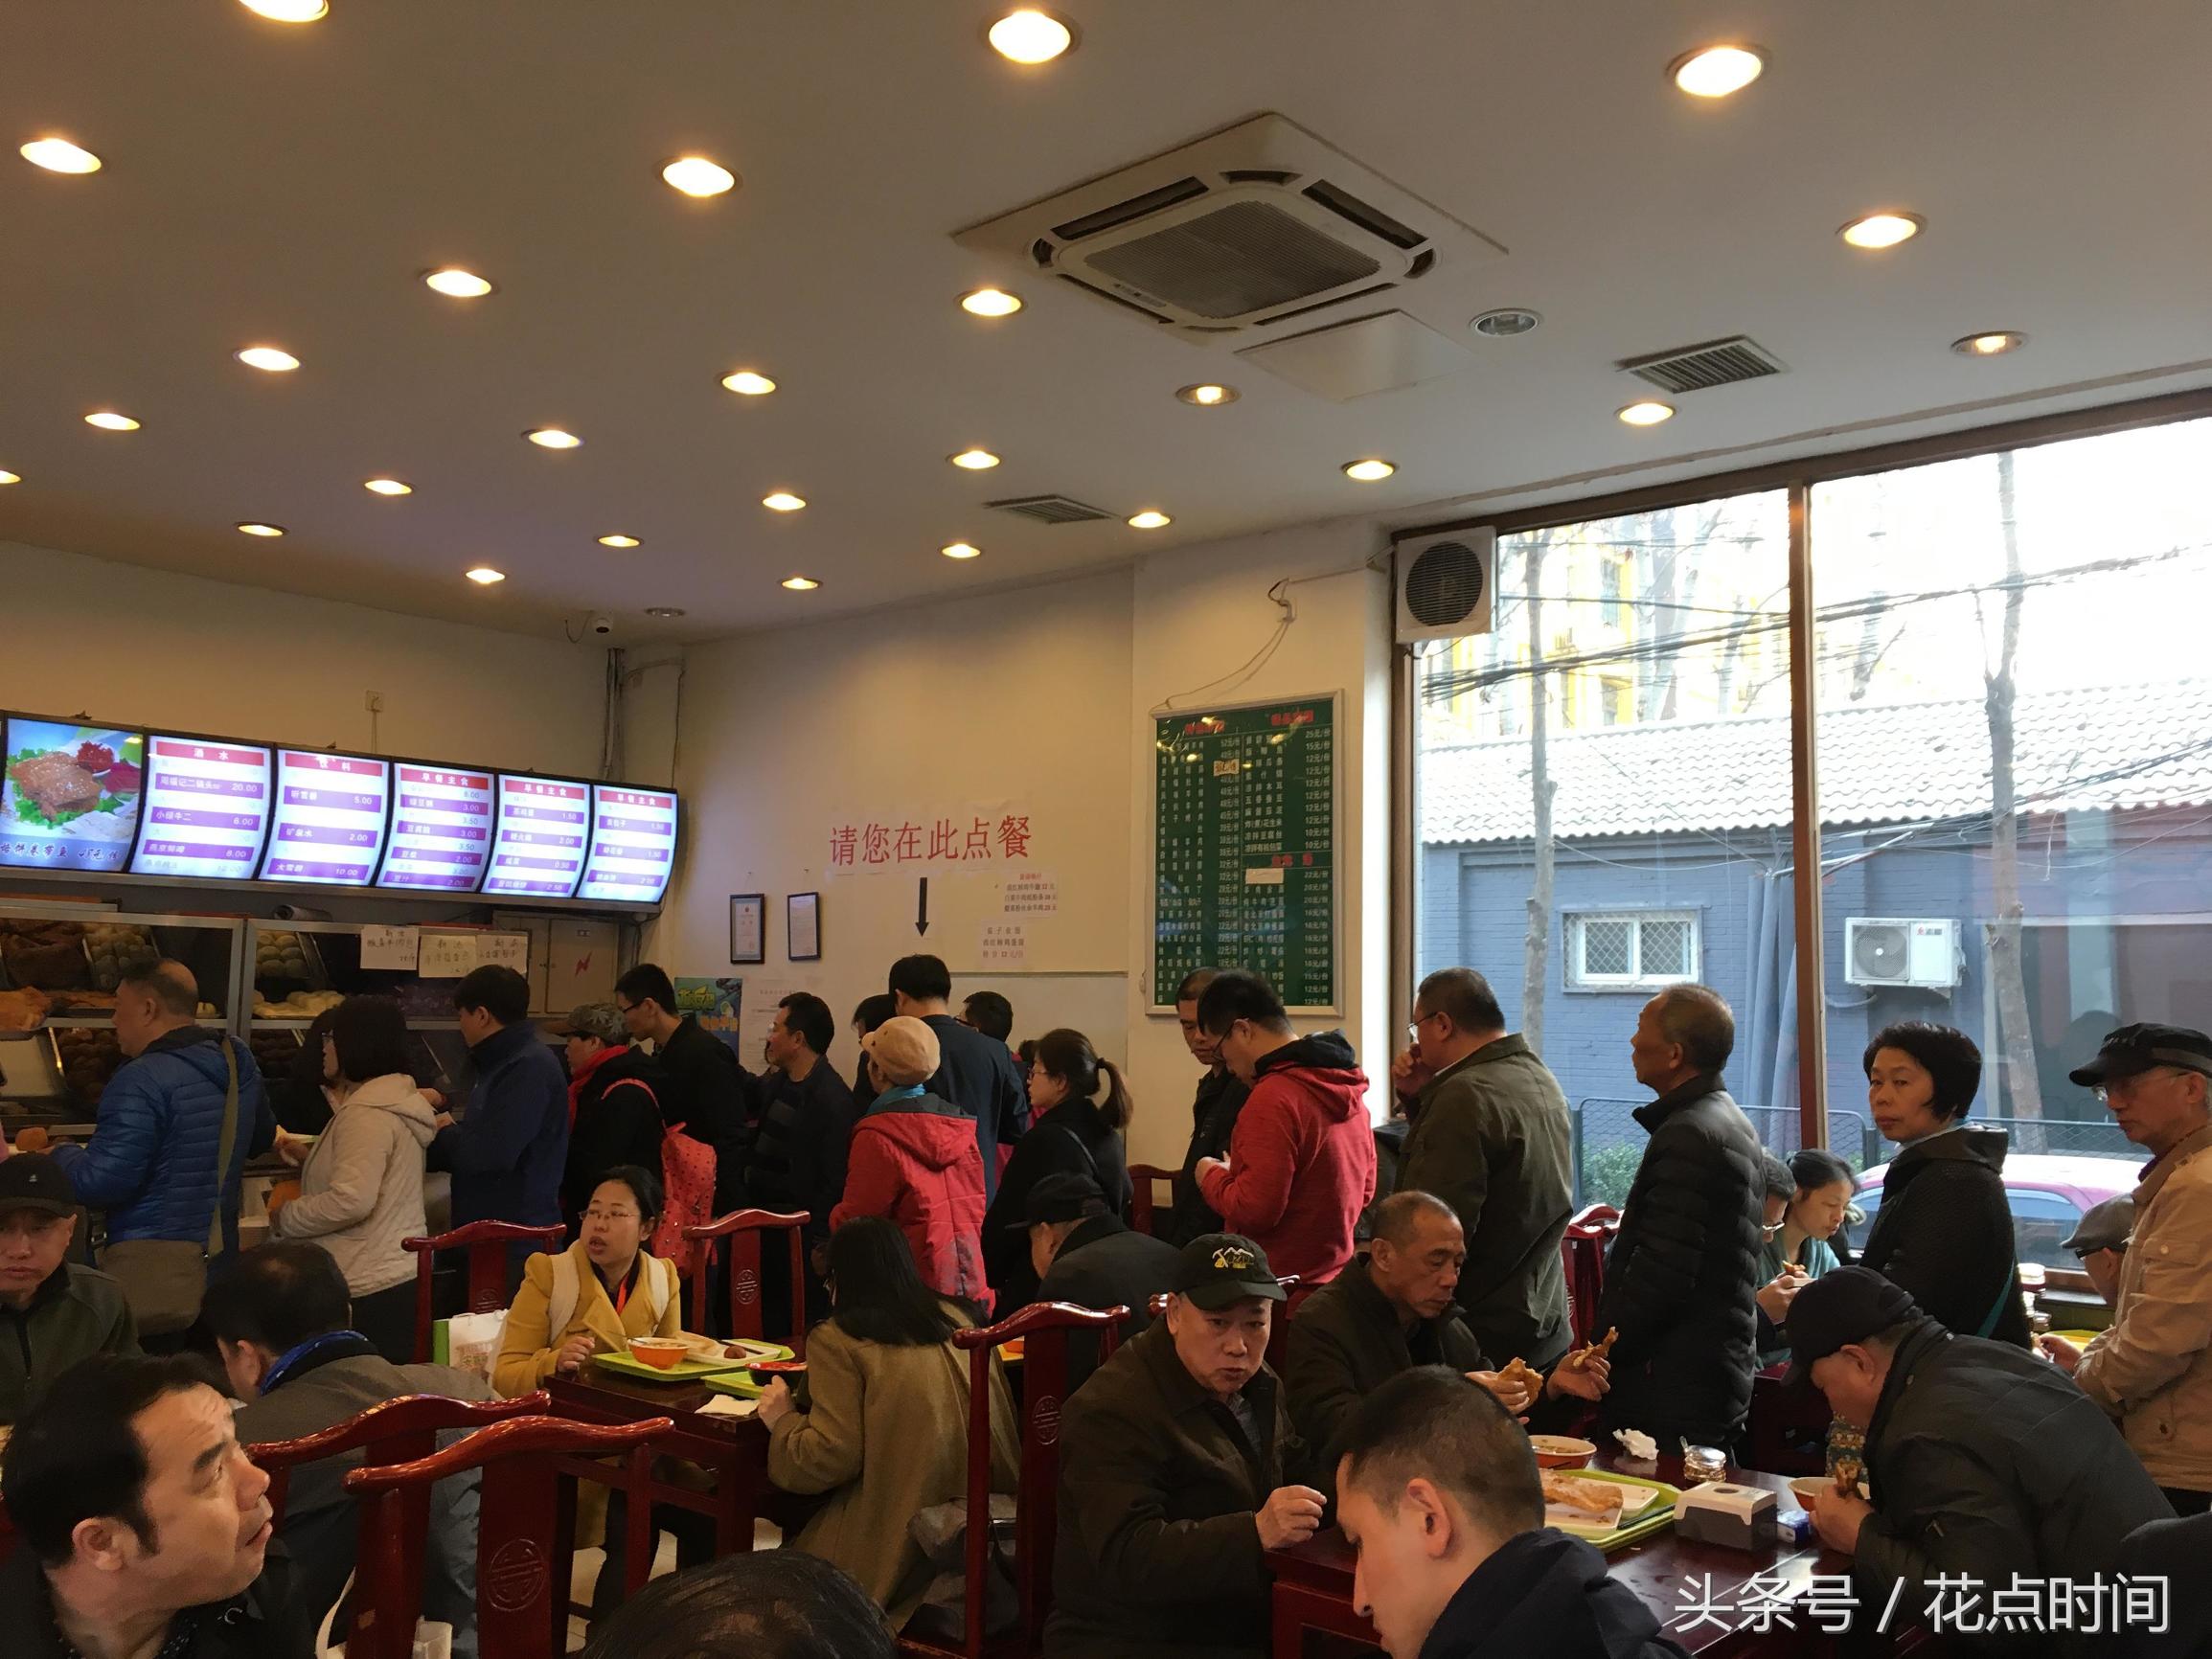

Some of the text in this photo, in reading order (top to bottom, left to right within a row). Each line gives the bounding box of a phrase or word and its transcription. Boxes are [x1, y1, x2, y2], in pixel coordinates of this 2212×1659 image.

[829, 814, 1033, 866] 请您在此点餐
